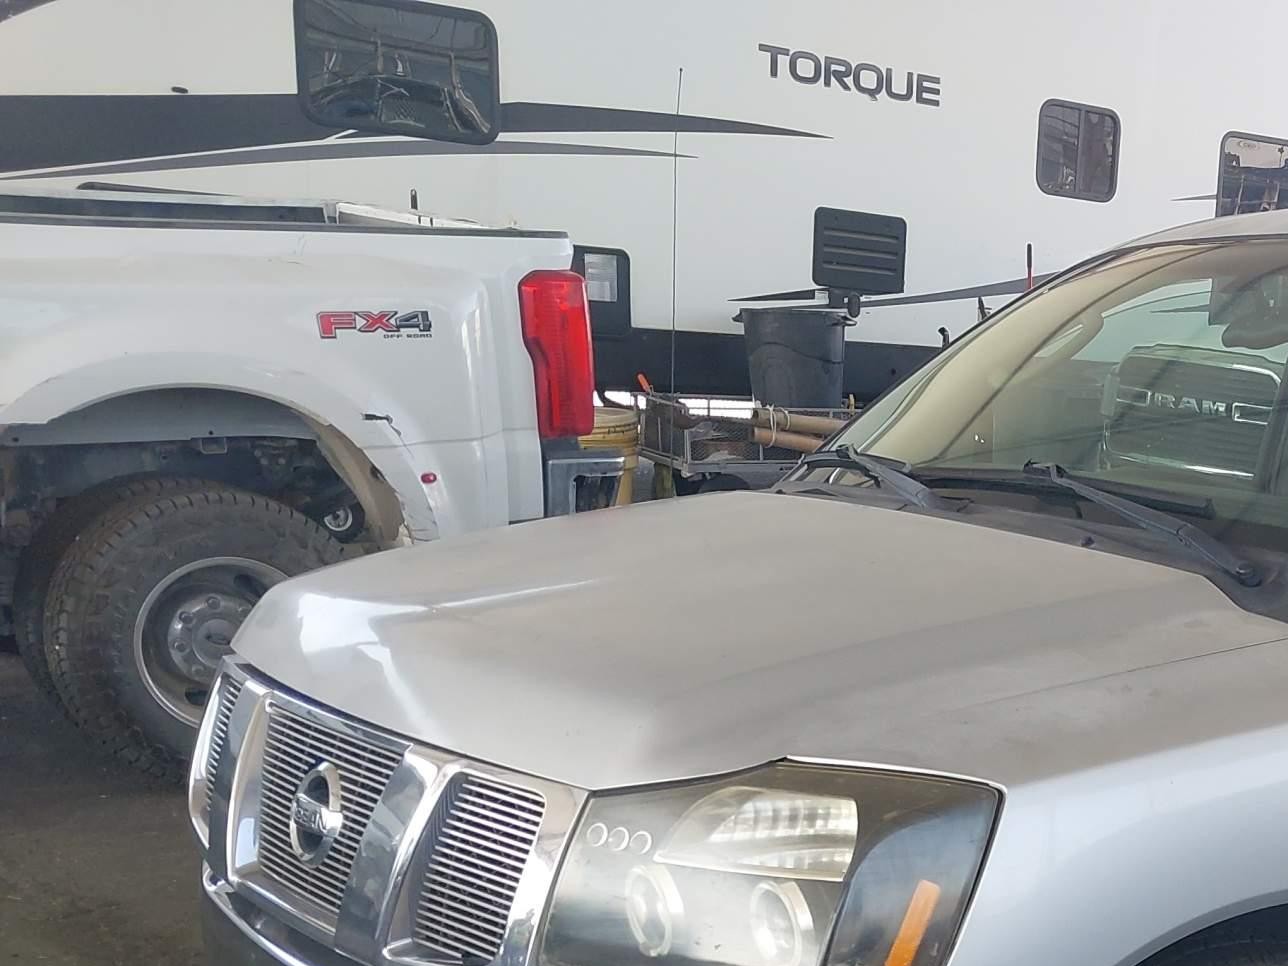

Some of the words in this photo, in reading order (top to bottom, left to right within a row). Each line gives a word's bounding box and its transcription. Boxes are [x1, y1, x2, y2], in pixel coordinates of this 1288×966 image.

[757, 43, 941, 107] TORQUE
[316, 310, 432, 339] FX4
[1153, 391, 1228, 417] RAM
